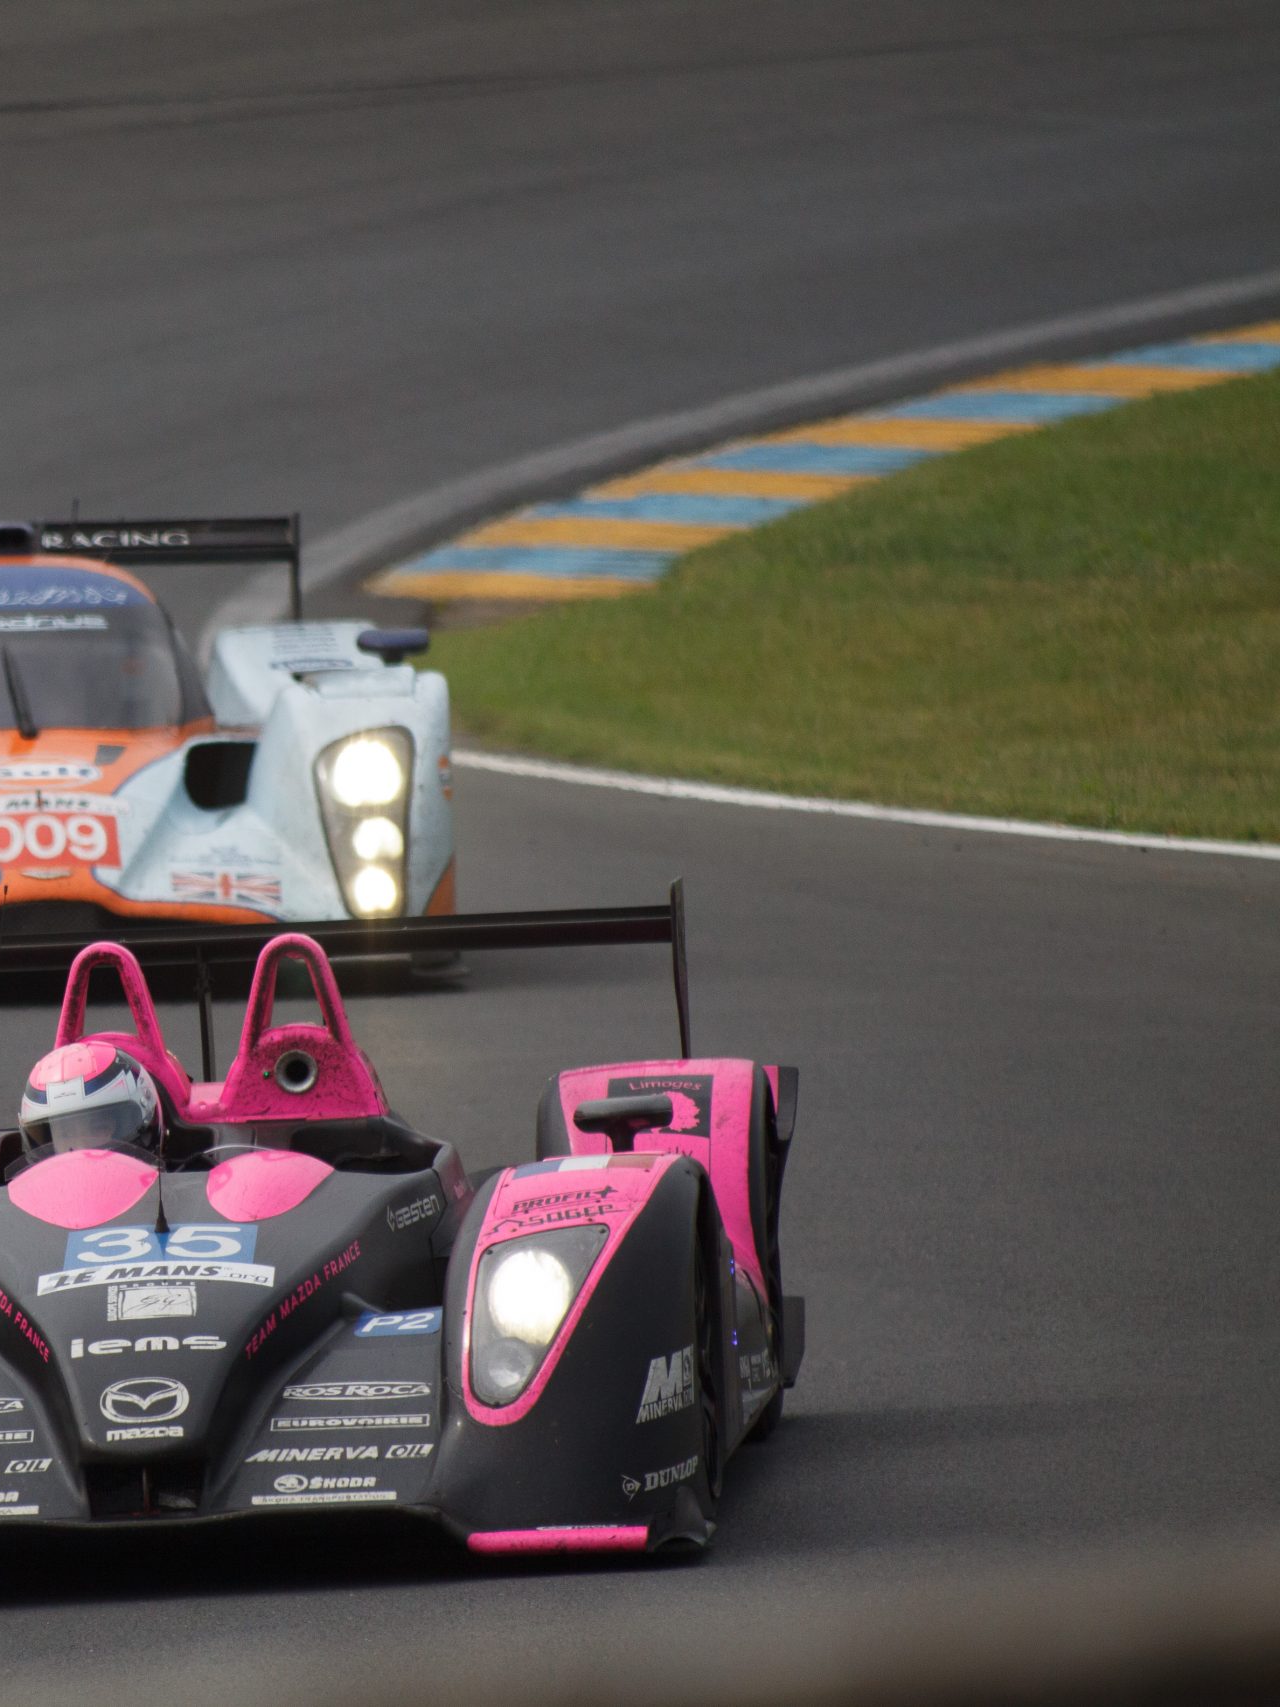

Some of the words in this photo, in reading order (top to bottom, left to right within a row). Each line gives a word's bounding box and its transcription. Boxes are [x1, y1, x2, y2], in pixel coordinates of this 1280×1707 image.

[41, 529, 190, 548] RACING
[629, 1080, 702, 1091] Limoges
[77, 1227, 242, 1262] 35
[54, 1270, 96, 1288] LE
[245, 1313, 277, 1360] TEAM
[279, 1273, 322, 1319] MAZDA
[323, 1240, 362, 1281] FRANCE
[361, 1311, 435, 1333] P2
[14, 1312, 50, 1363] FRANCE
[283, 1386, 343, 1398] ROS
[346, 1384, 431, 1397] ROCA
[635, 1394, 684, 1424] MINERVA
[277, 1416, 424, 1428] EUROVOIRIE
[244, 1446, 378, 1463] MINERVA
[386, 1444, 433, 1459] OIL
[6, 1458, 52, 1474] OIL
[644, 1455, 699, 1491] DUNLOP
